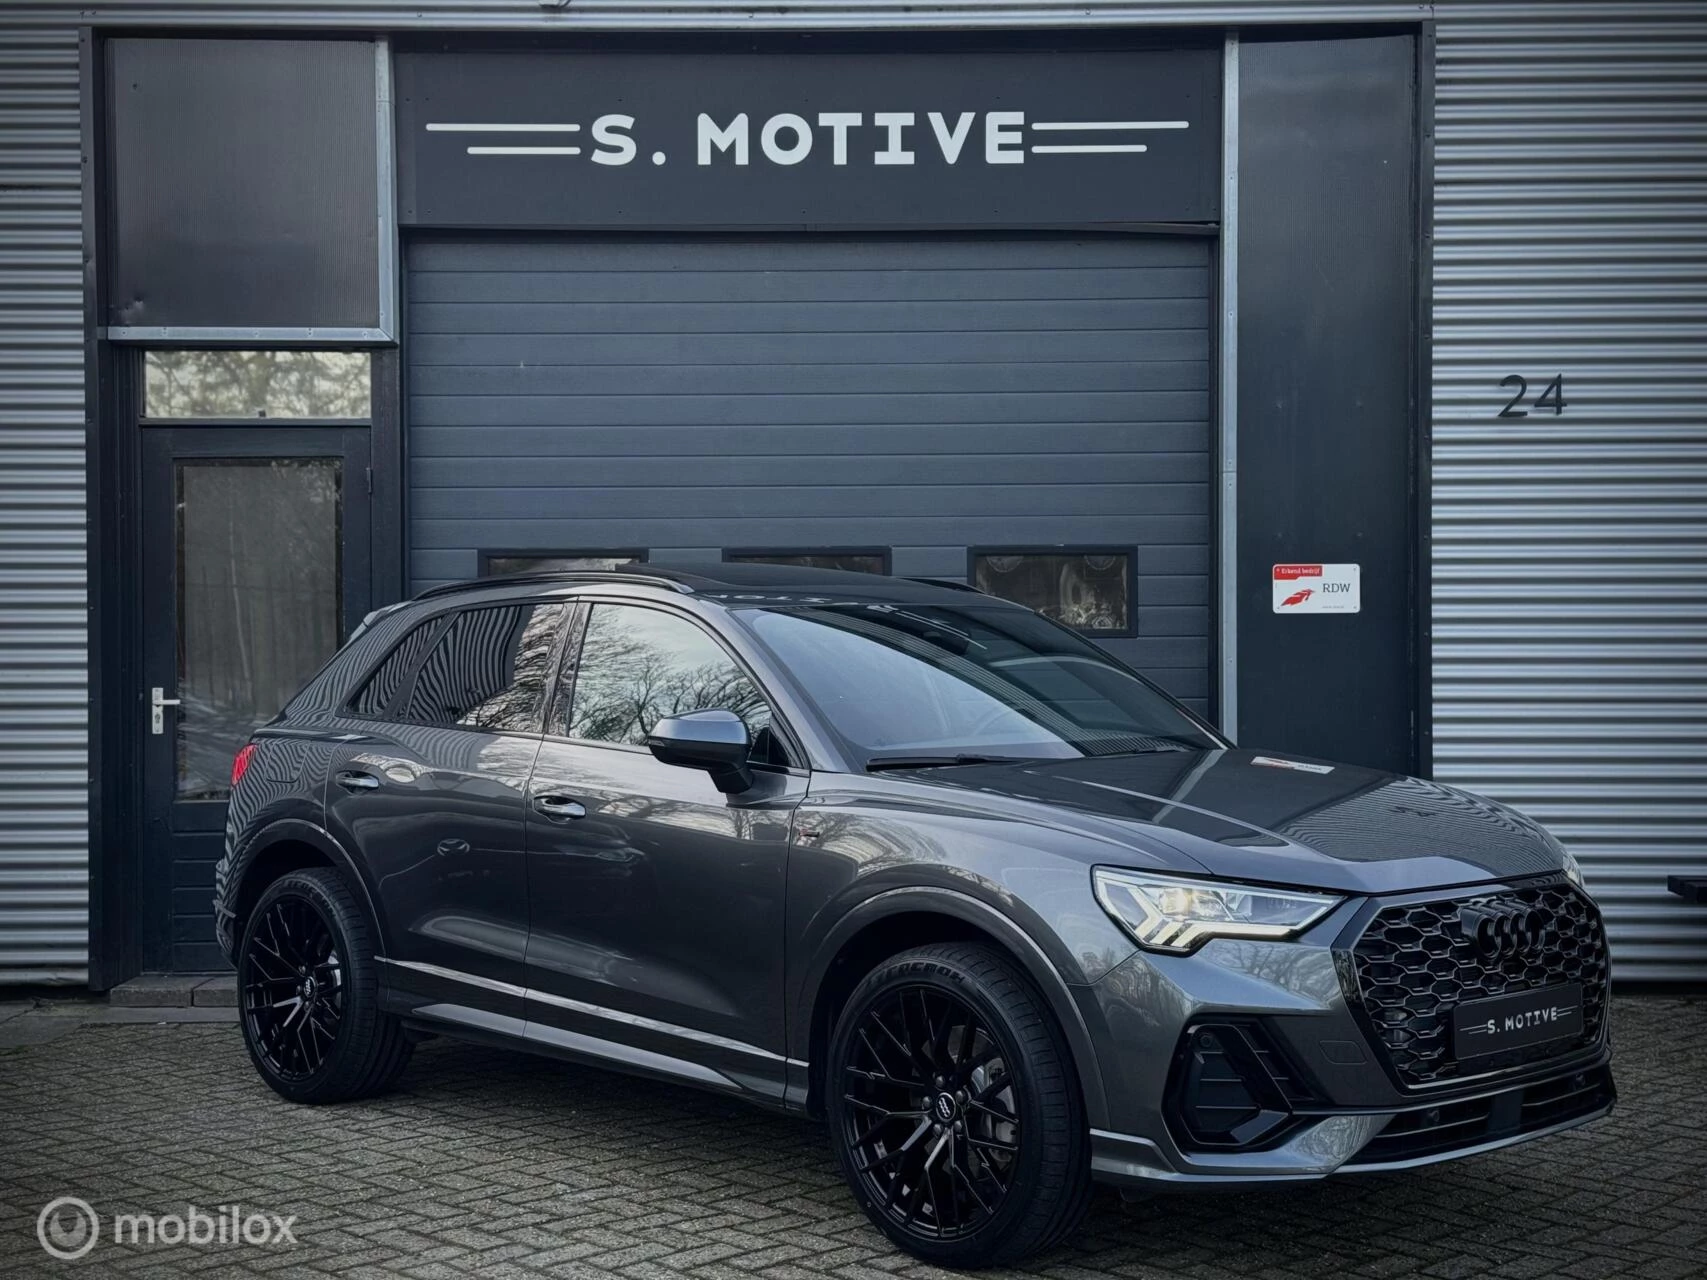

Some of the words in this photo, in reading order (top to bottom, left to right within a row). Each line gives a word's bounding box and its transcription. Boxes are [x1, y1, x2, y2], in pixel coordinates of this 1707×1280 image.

[590, 115, 666, 166] S.
[697, 111, 1025, 166] MOTIVE
[1497, 373, 1568, 418] 24
[1322, 583, 1351, 593] RDW
[1487, 1019, 1500, 1034] S.
[1505, 1006, 1557, 1031] MOTIVE
